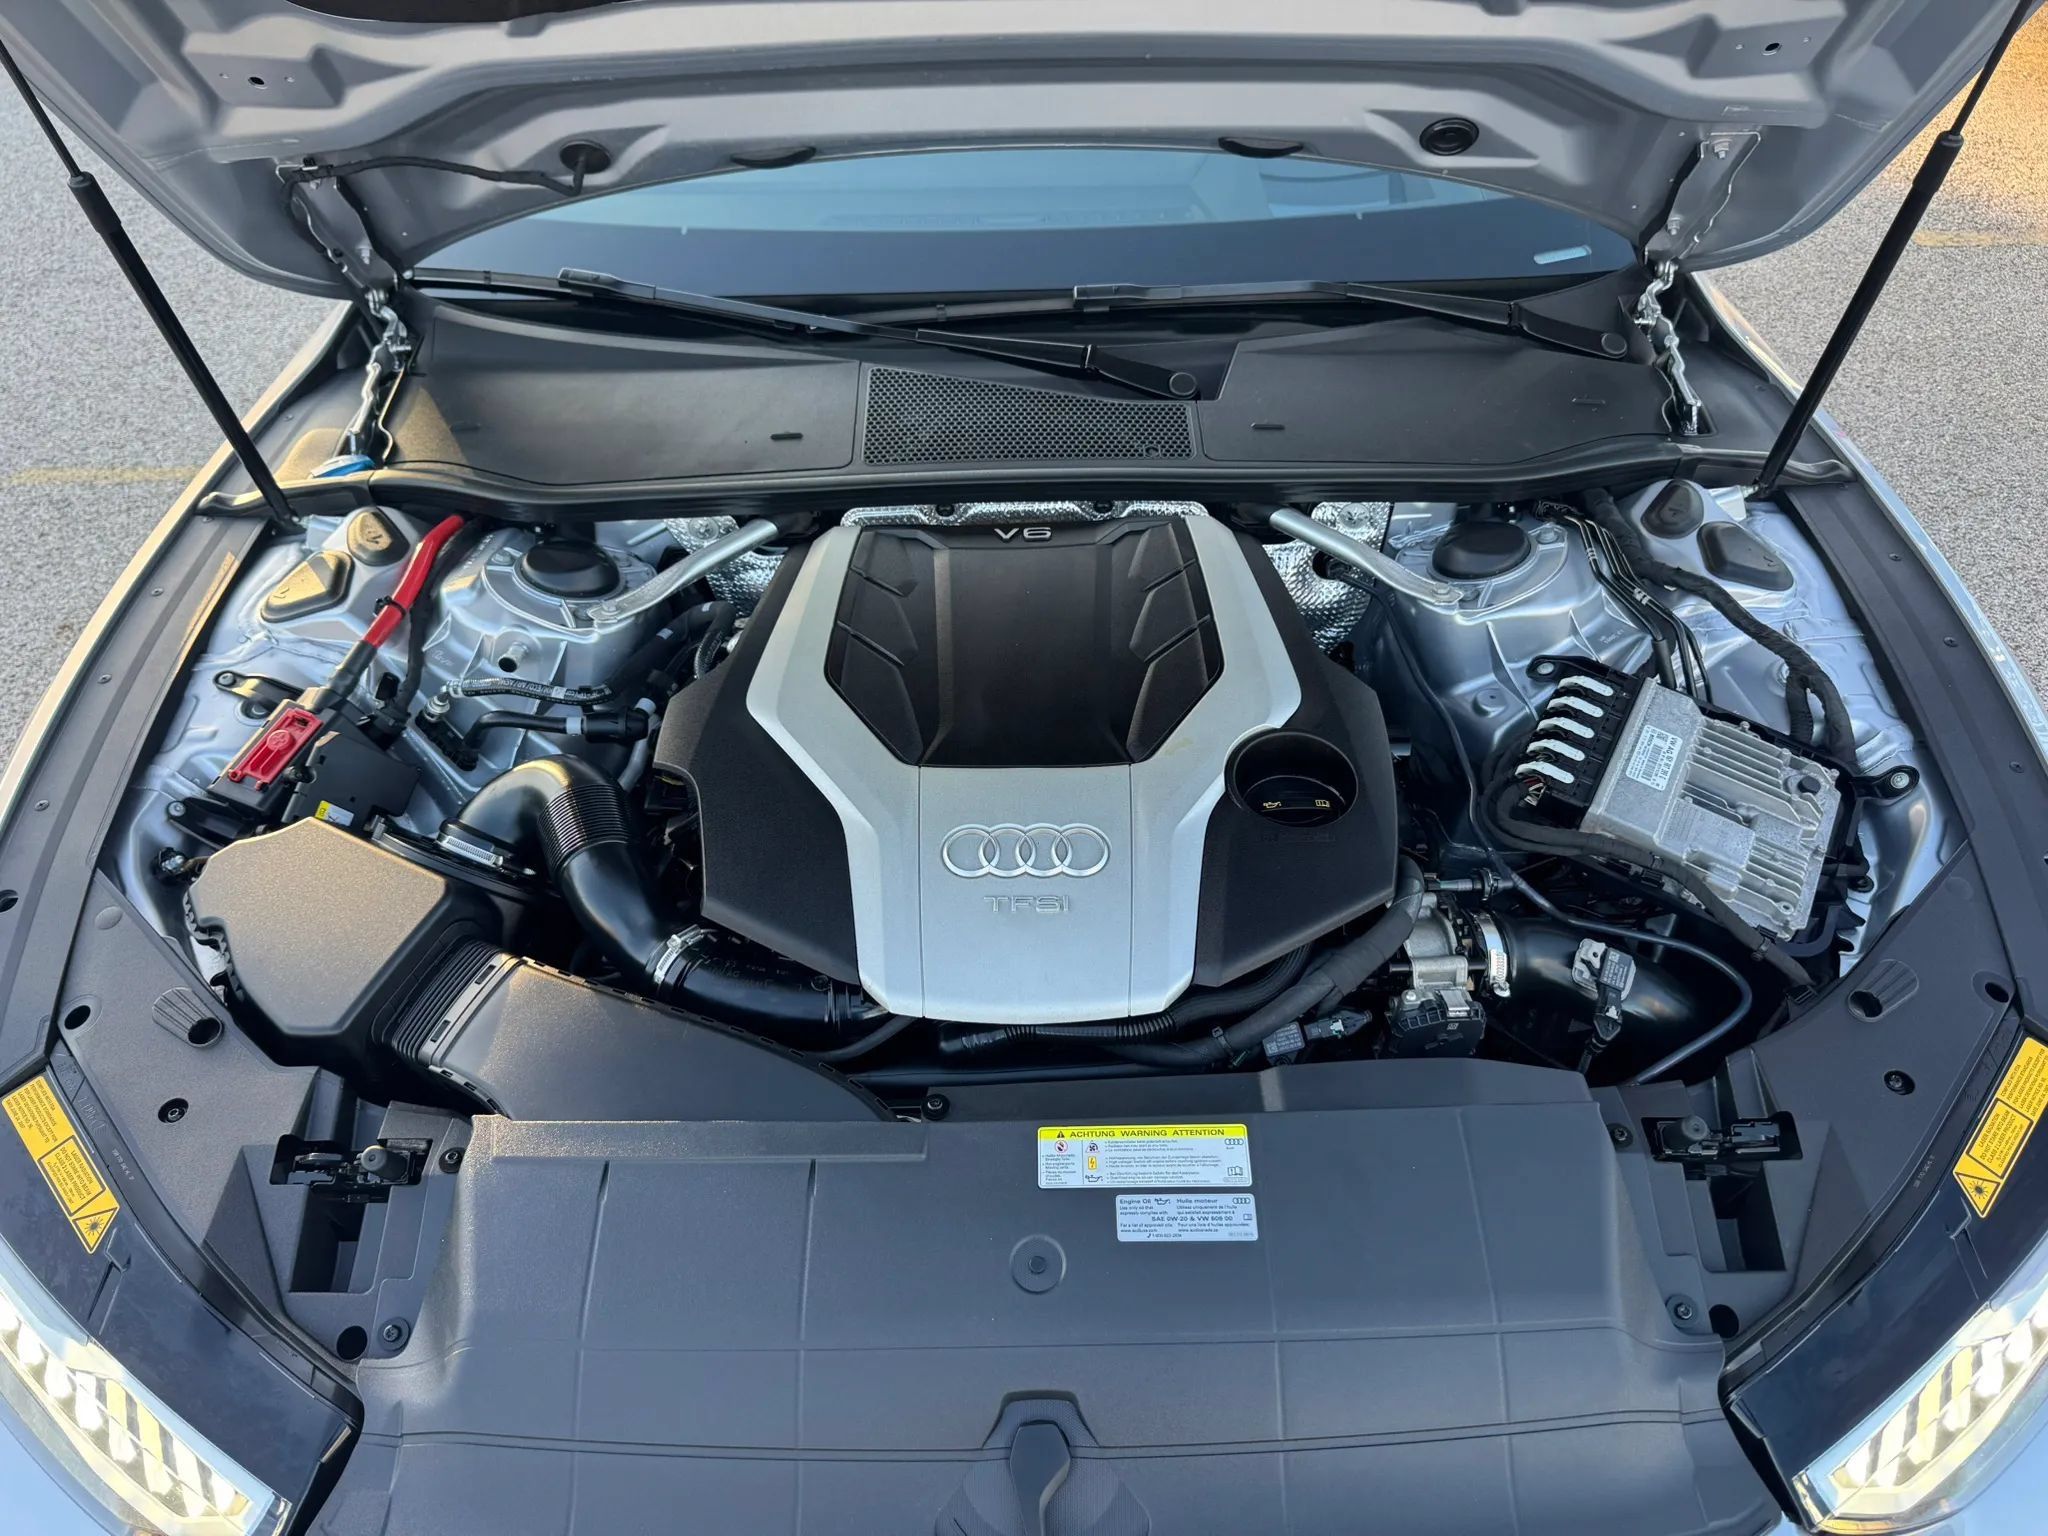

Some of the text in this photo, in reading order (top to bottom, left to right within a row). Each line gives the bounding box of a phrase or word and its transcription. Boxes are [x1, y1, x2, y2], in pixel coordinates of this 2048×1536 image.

[994, 527, 1052, 541] V6
[984, 895, 1070, 914] TFSI
[1070, 1130, 1115, 1138] ACHTUNG
[1120, 1129, 1167, 1137] WARNING
[1978, 1133, 1989, 1147] LASER
[1983, 1143, 1991, 1153] NOT
[1988, 1130, 1998, 1144] STARE
[1986, 1148, 1997, 1163] CLASS
[1995, 1132, 2006, 1146] LASER
[2002, 1113, 2016, 1133] PRODUCT
[63, 1153, 71, 1162] NOT
[68, 1161, 79, 1175] STARE
[70, 1149, 81, 1163] LASER
[54, 1152, 65, 1166] CLASS
[63, 1167, 74, 1181] LASER
[70, 1180, 85, 1200] PRODUCT
